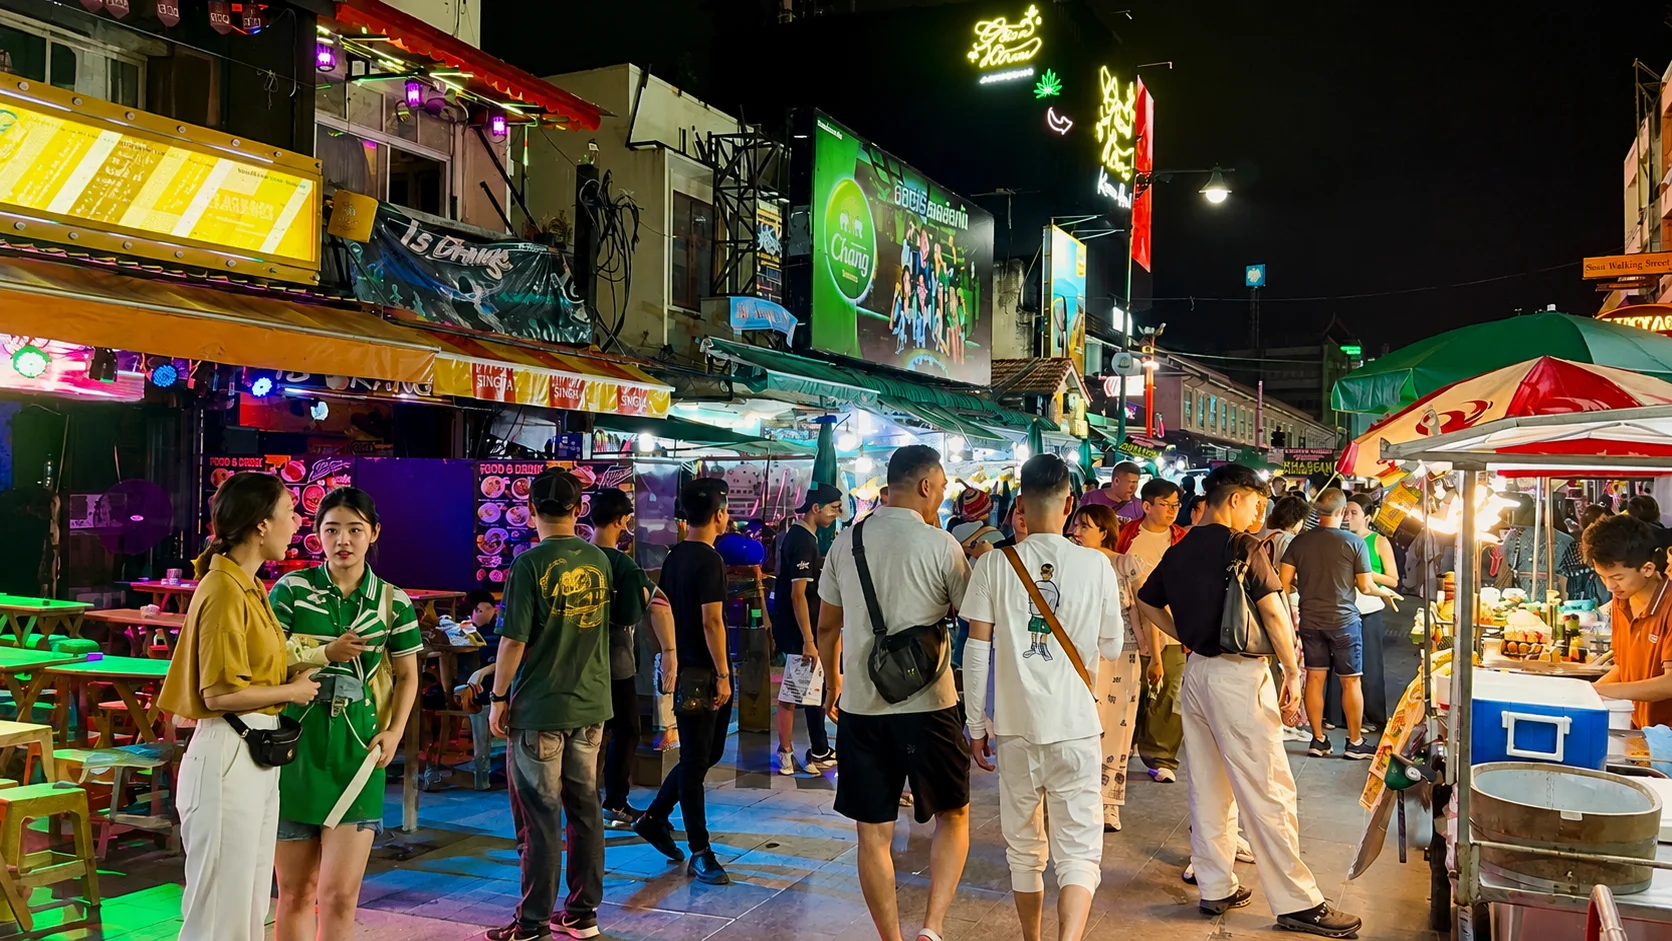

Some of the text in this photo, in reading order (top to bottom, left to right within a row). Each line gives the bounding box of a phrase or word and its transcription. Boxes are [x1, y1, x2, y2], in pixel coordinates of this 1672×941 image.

[831, 233, 869, 278] Chang
[477, 375, 514, 391] SINGA
[210, 457, 231, 467] FOOD
[481, 464, 505, 474] FOOD
